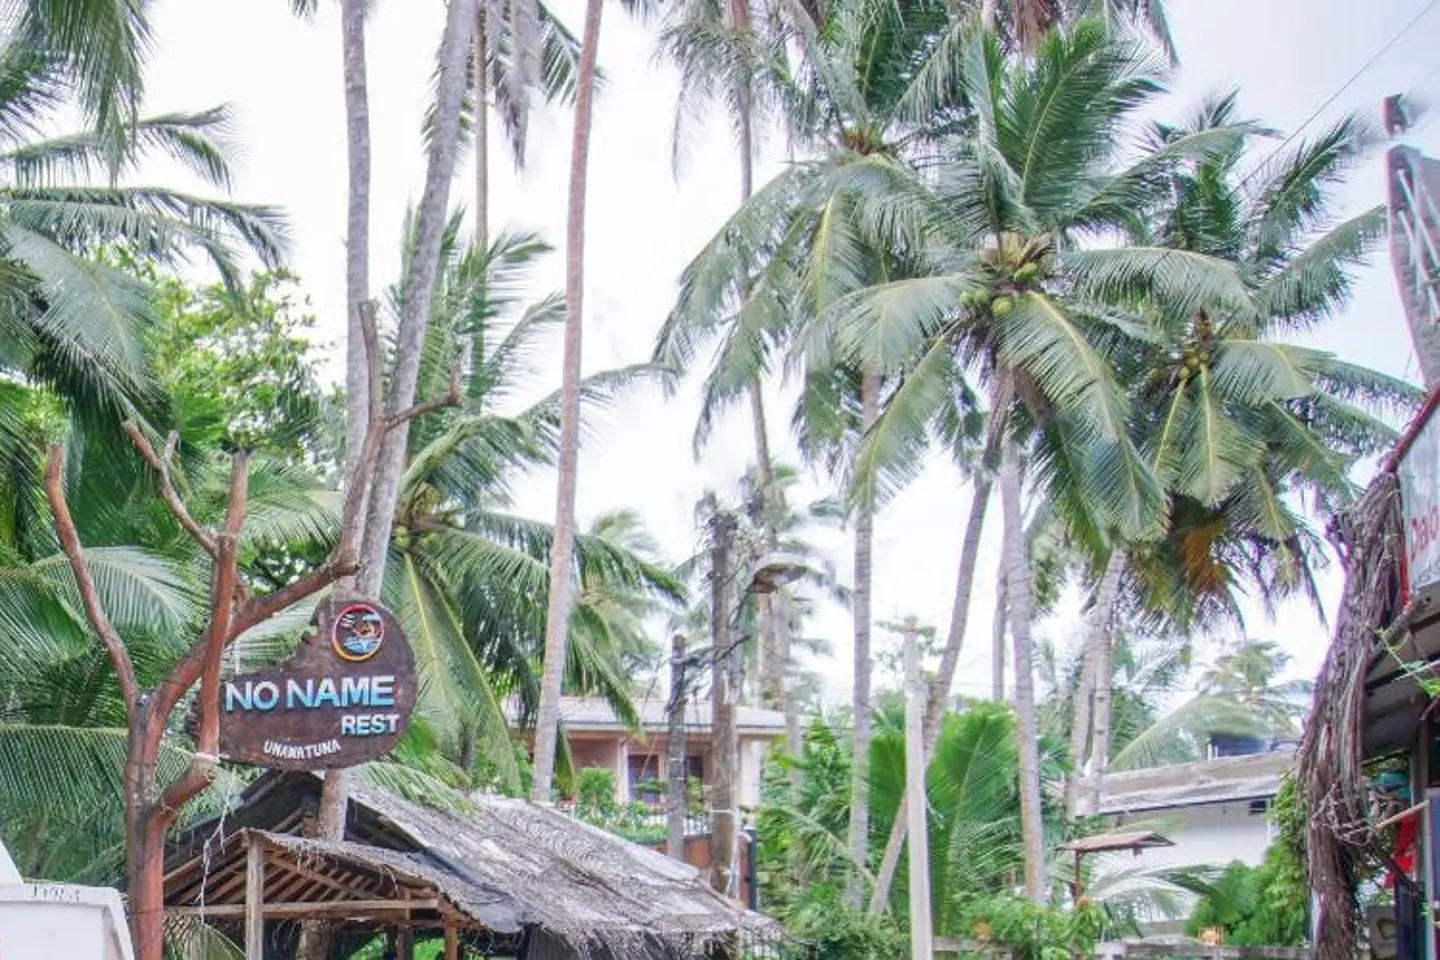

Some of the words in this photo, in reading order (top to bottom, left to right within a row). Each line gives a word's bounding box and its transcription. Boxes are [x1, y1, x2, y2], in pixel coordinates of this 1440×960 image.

[224, 681, 280, 712] NO
[286, 675, 395, 709] NAME
[341, 714, 400, 735] REST
